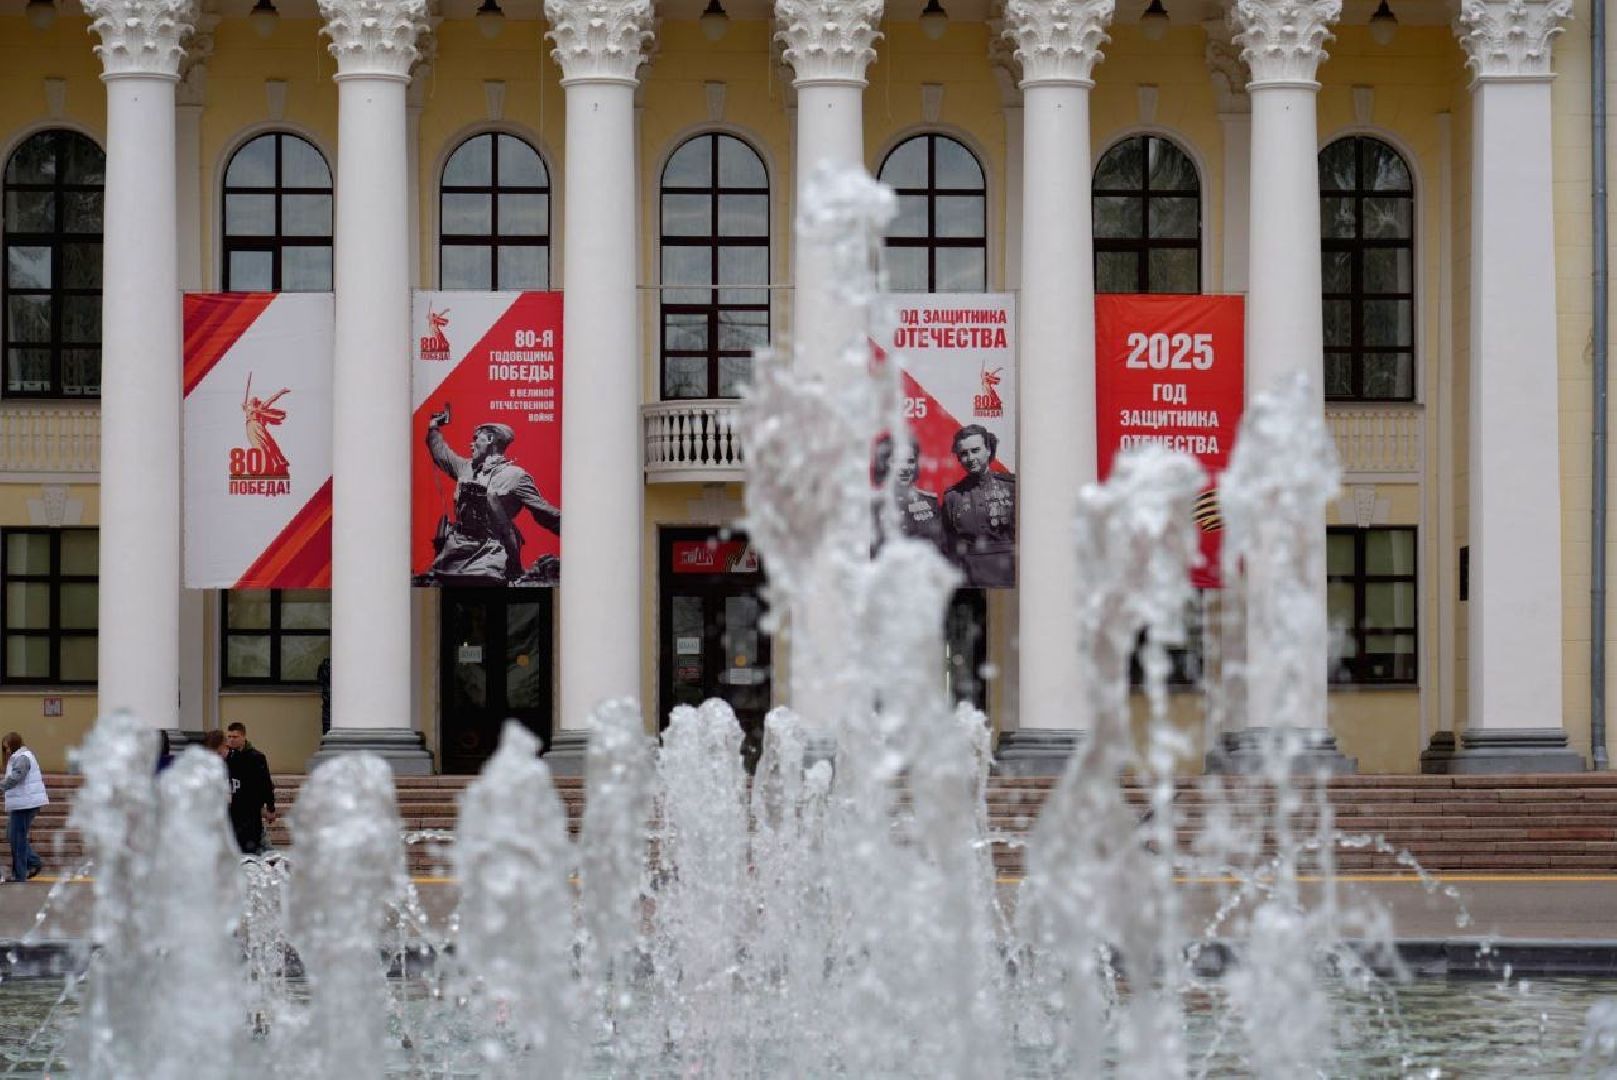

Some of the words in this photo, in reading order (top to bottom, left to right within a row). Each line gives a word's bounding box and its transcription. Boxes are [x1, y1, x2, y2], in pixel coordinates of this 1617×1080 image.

[897, 309, 919, 325] ОД
[923, 309, 1007, 325] ЗАЩИТНИКА
[515, 330, 553, 347] 80-Я
[894, 327, 1007, 348] ОТЕЧЕСТВА
[489, 351, 554, 363] ГОДОВЩИНА
[1126, 333, 1214, 370] 2025
[489, 365, 554, 382] ПОБЕДЫ
[1152, 383, 1187, 405] ГОД
[1120, 410, 1219, 429] ЗАЩИТНИКА
[230, 448, 262, 475] 80
[229, 481, 291, 497] ПОБЕДА!
